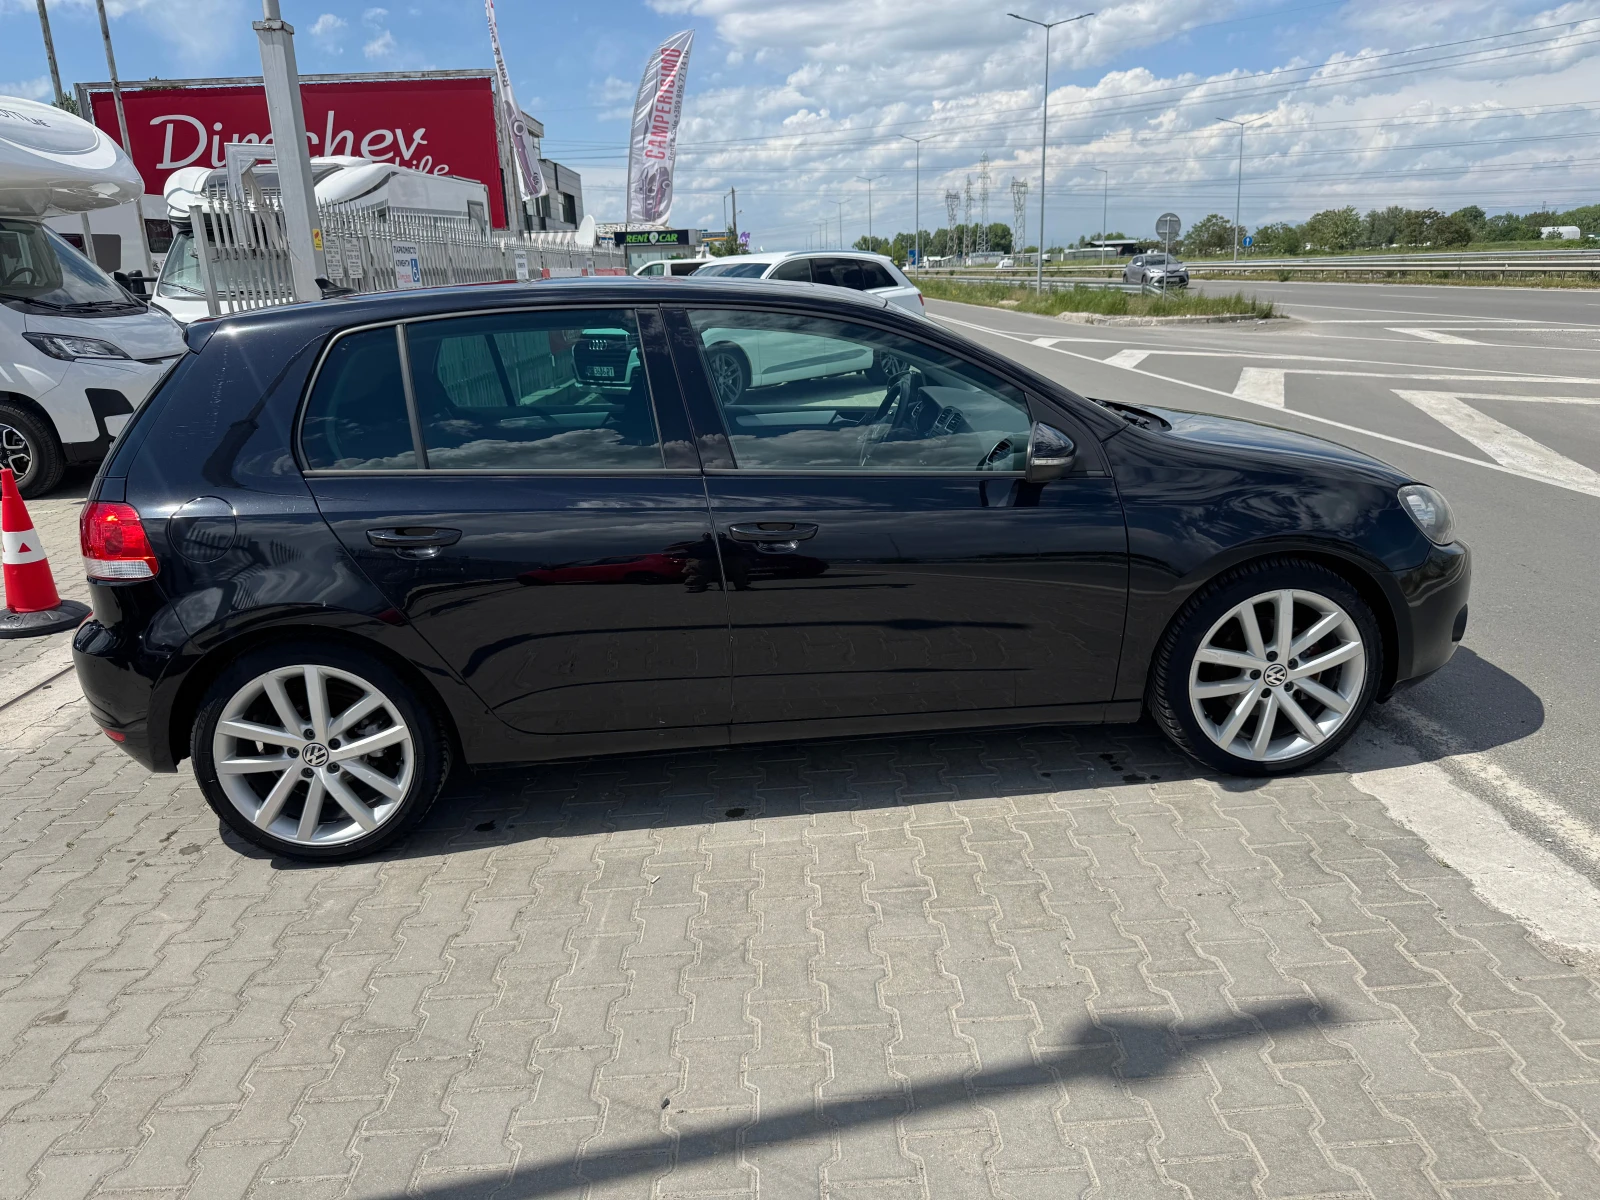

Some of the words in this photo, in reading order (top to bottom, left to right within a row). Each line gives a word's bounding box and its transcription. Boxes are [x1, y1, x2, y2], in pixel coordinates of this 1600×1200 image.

[497, 58, 509, 88] Rent
[645, 48, 682, 160] CAMPERISIMO
[150, 110, 427, 170] Dihev
[668, 143, 676, 161] Rent
[659, 233, 678, 242] CAR
